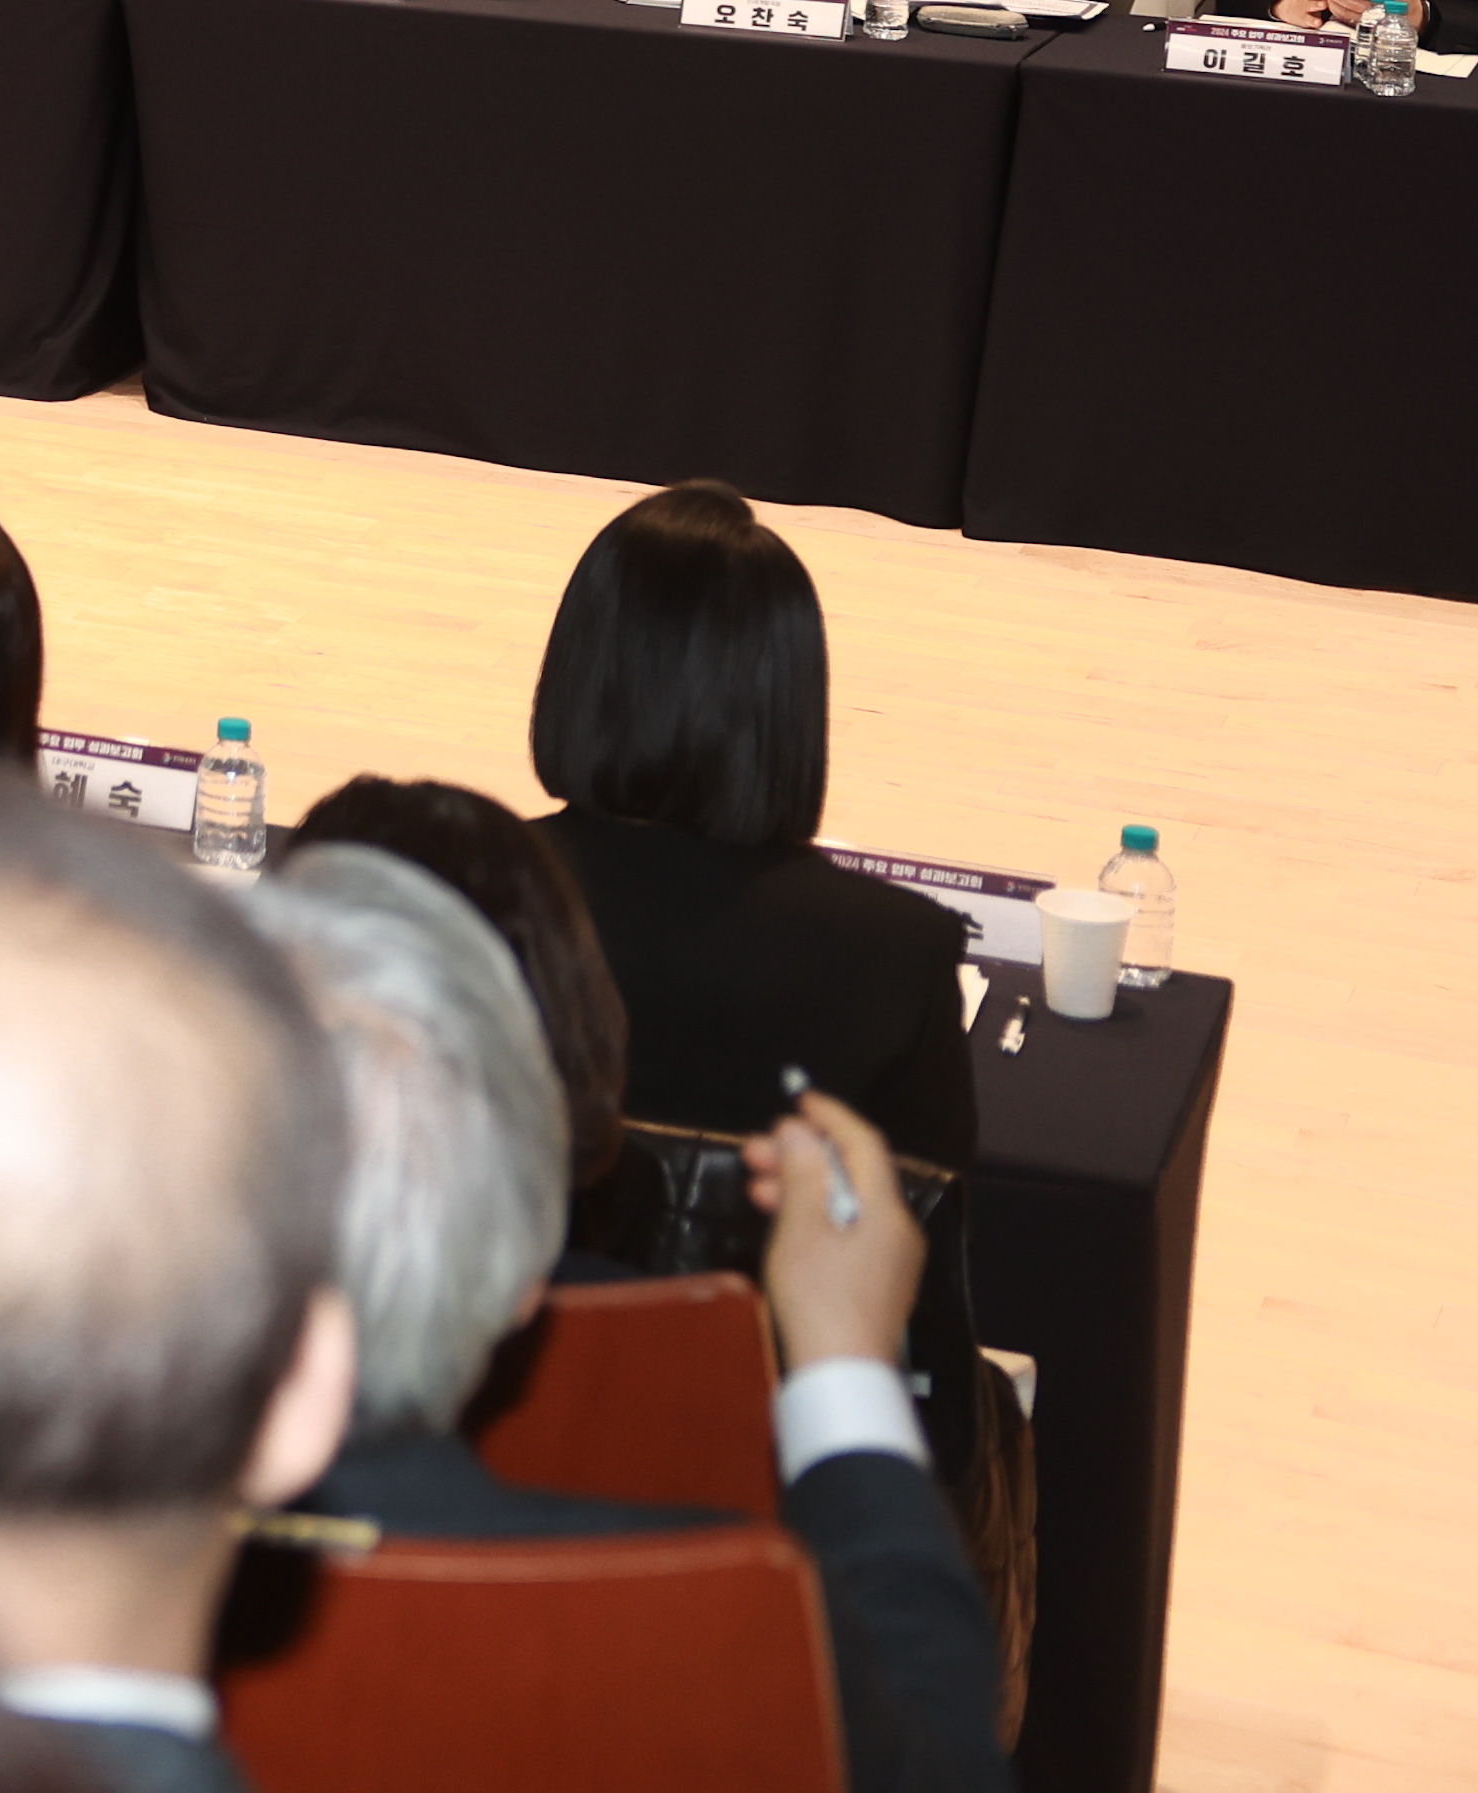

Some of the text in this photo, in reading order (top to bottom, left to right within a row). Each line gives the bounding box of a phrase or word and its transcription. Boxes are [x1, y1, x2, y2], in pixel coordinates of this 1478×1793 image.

[714, 3, 809, 32] 오찬숙
[1203, 48, 1306, 78] 이길호
[53, 771, 142, 818] 혜숙
